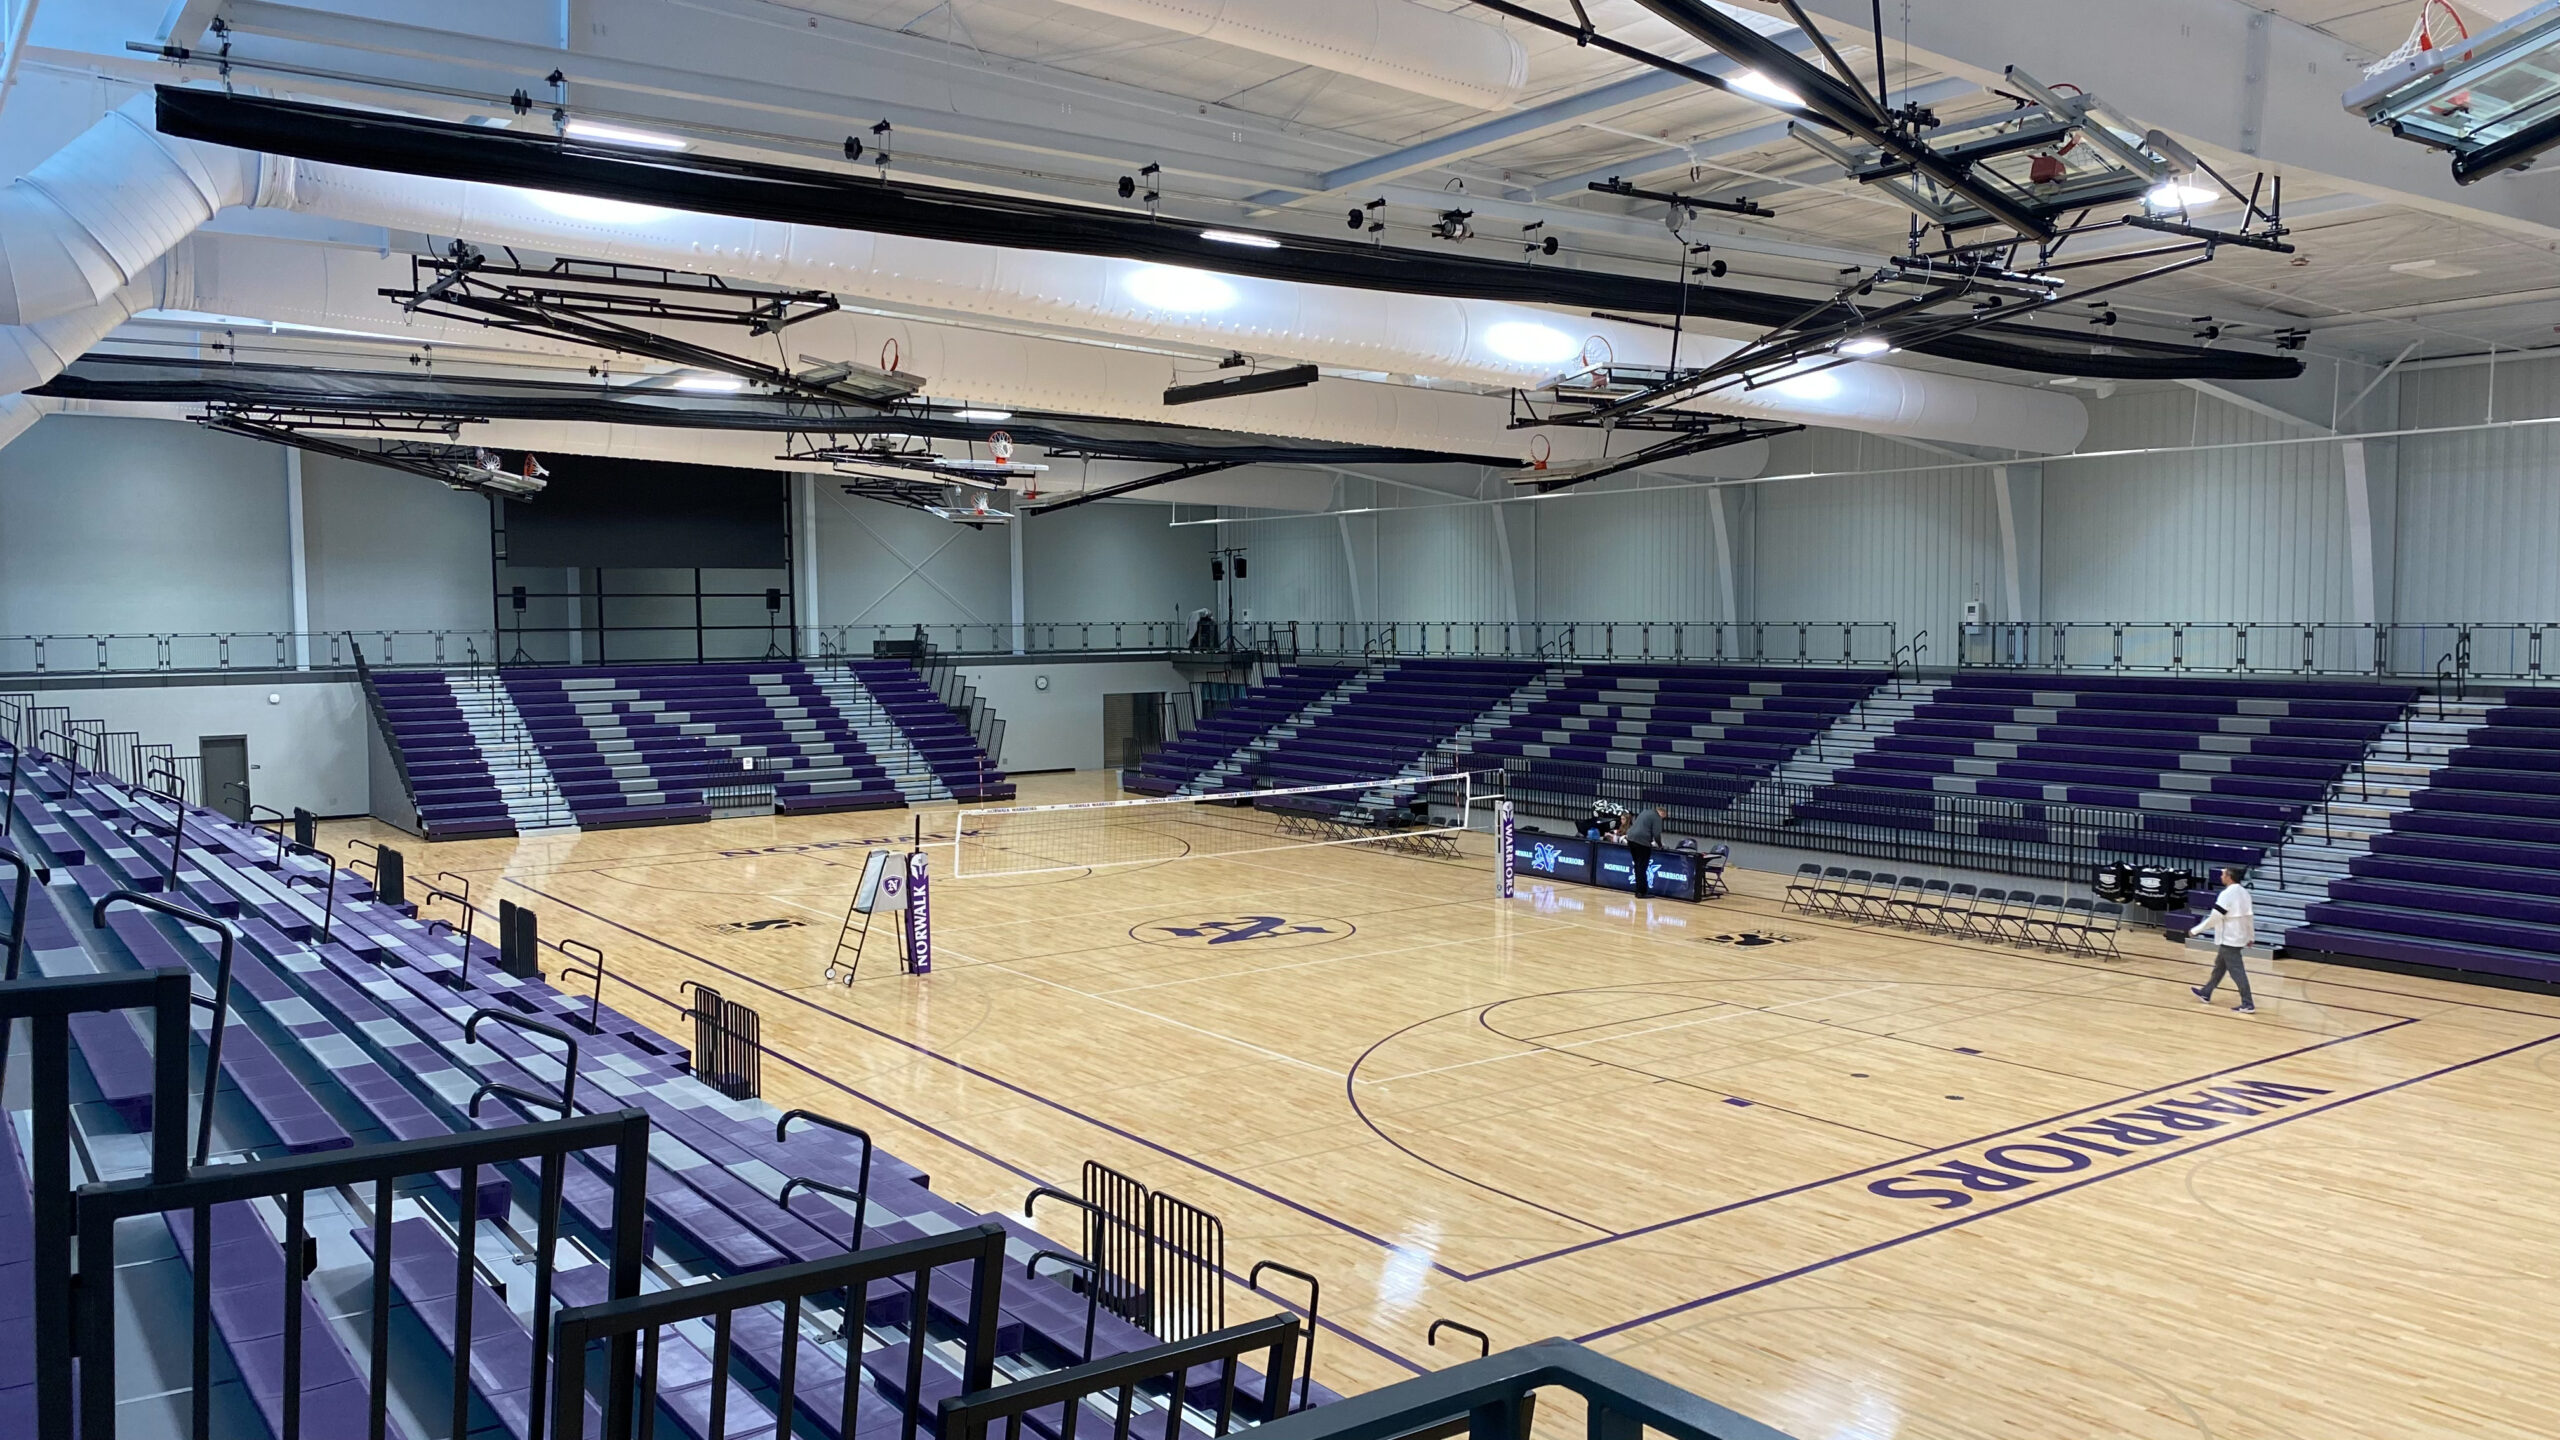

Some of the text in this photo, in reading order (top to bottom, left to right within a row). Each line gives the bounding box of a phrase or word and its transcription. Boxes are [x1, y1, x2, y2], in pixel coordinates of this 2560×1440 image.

[1504, 823, 1514, 895] WARRIORS
[1557, 855, 1585, 867] WARRIORS
[1603, 862, 1688, 882] NORWALK WARRIORS
[913, 884, 928, 967] NORWALK
[1867, 1080, 2335, 1210] WARRIORS
